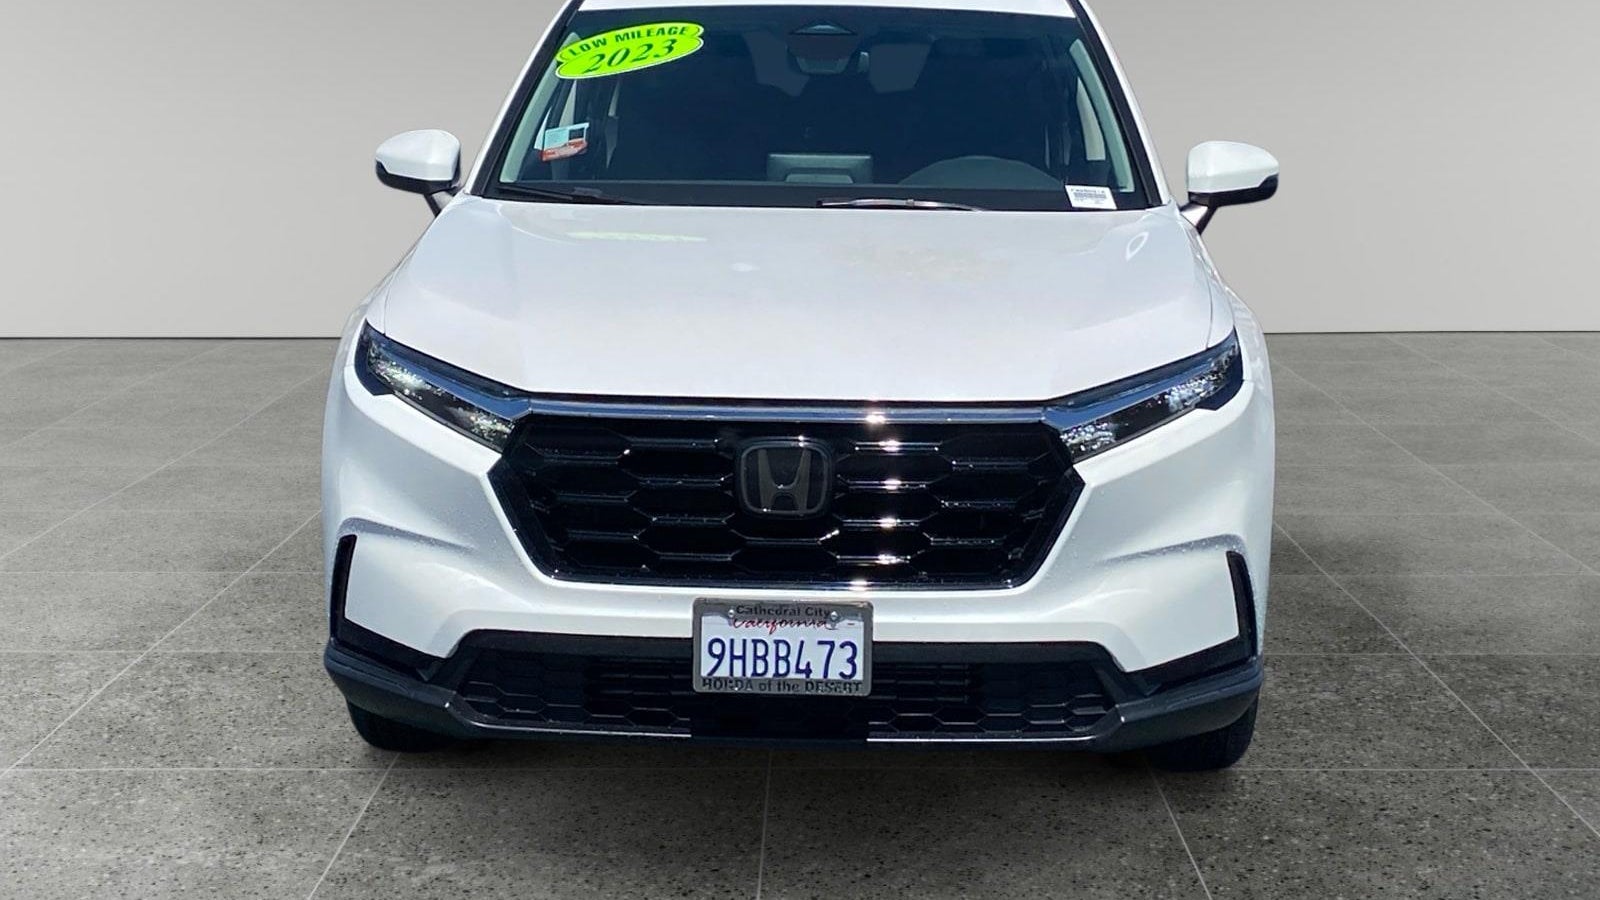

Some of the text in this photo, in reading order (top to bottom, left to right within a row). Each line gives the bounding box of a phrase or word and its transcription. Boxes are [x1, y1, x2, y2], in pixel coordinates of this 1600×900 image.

[569, 26, 690, 56] LOW MILEAGE
[583, 38, 678, 74] 2023
[736, 605, 831, 618] Cathedral City
[707, 637, 858, 680] 9HBB473
[759, 678, 772, 691] of
[777, 679, 800, 692] the
[804, 680, 863, 693] DESERT
